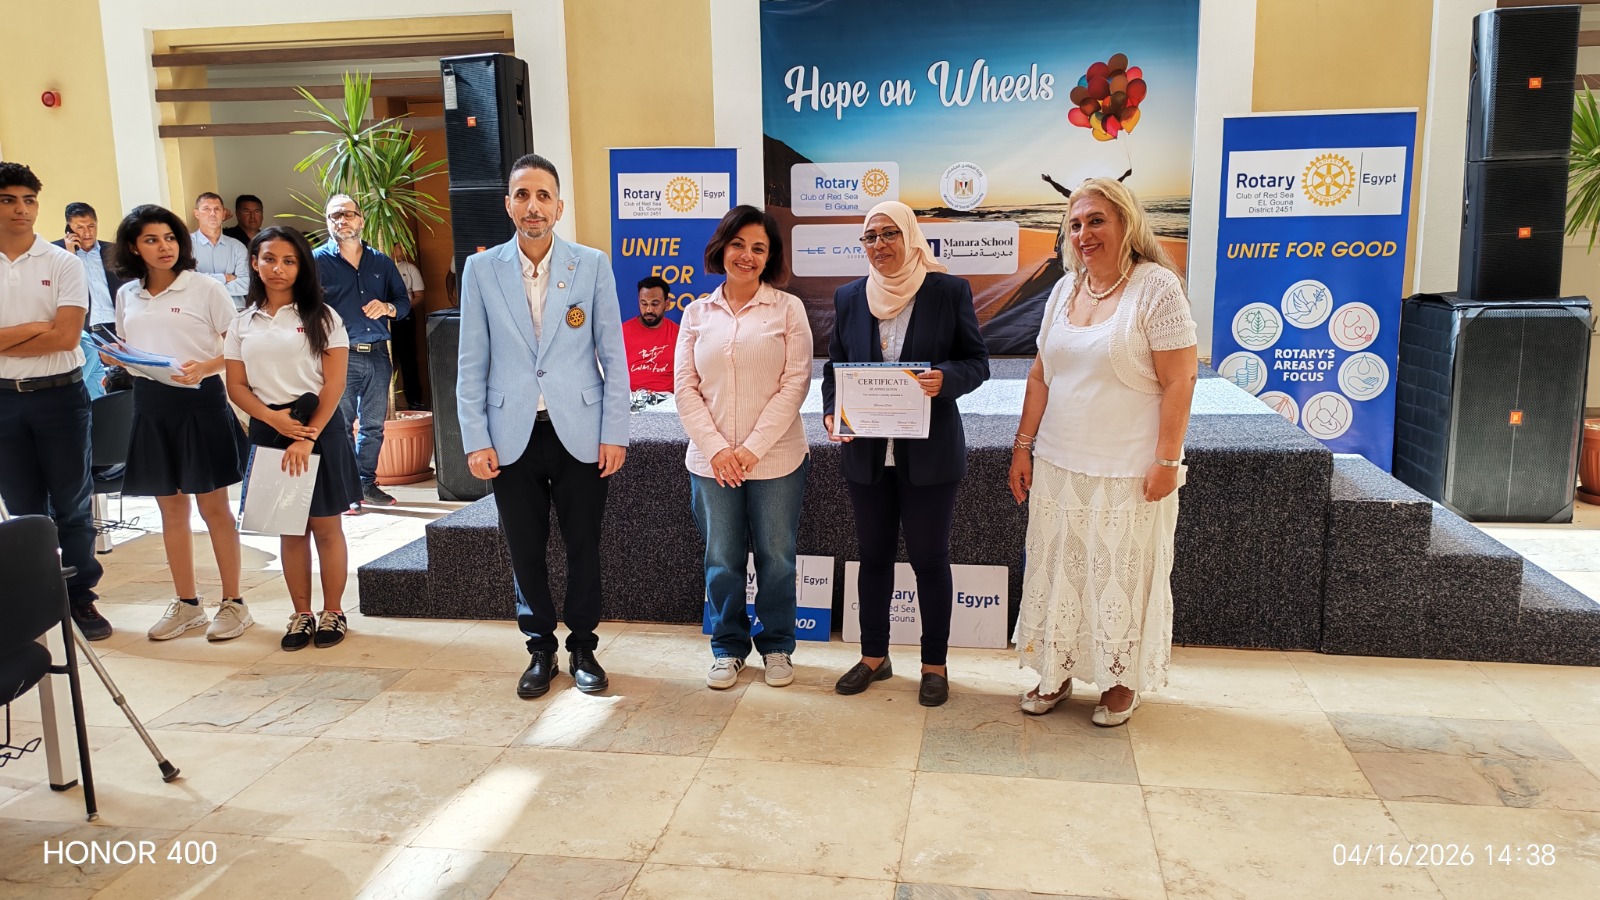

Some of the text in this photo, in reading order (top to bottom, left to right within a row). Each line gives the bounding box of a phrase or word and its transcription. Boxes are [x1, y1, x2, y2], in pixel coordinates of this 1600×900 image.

[784, 58, 1055, 121] Hope on Wheels
[815, 177, 859, 191] Rotary
[1236, 173, 1296, 191] Rotary
[1362, 173, 1397, 186] Egypt
[623, 188, 662, 201] Rotary
[703, 190, 725, 199] Egypt
[1280, 191, 1294, 199] Sea
[621, 237, 681, 257] UNITE
[943, 237, 1013, 247] Manara School
[980, 248, 1013, 259] مدرسة
[1227, 240, 1397, 259] UNITE FOR GOOD
[651, 265, 695, 285] FOR
[1274, 349, 1336, 359] ROTARY'S
[1273, 360, 1335, 371] AREAS OF
[857, 378, 909, 386] CERTIFICATE
[1283, 372, 1324, 382] FOCUS
[803, 575, 829, 586] Egypt
[891, 590, 916, 603] ary
[957, 591, 1000, 608] Egypt
[889, 604, 899, 612] ed
[900, 604, 916, 613] Sea
